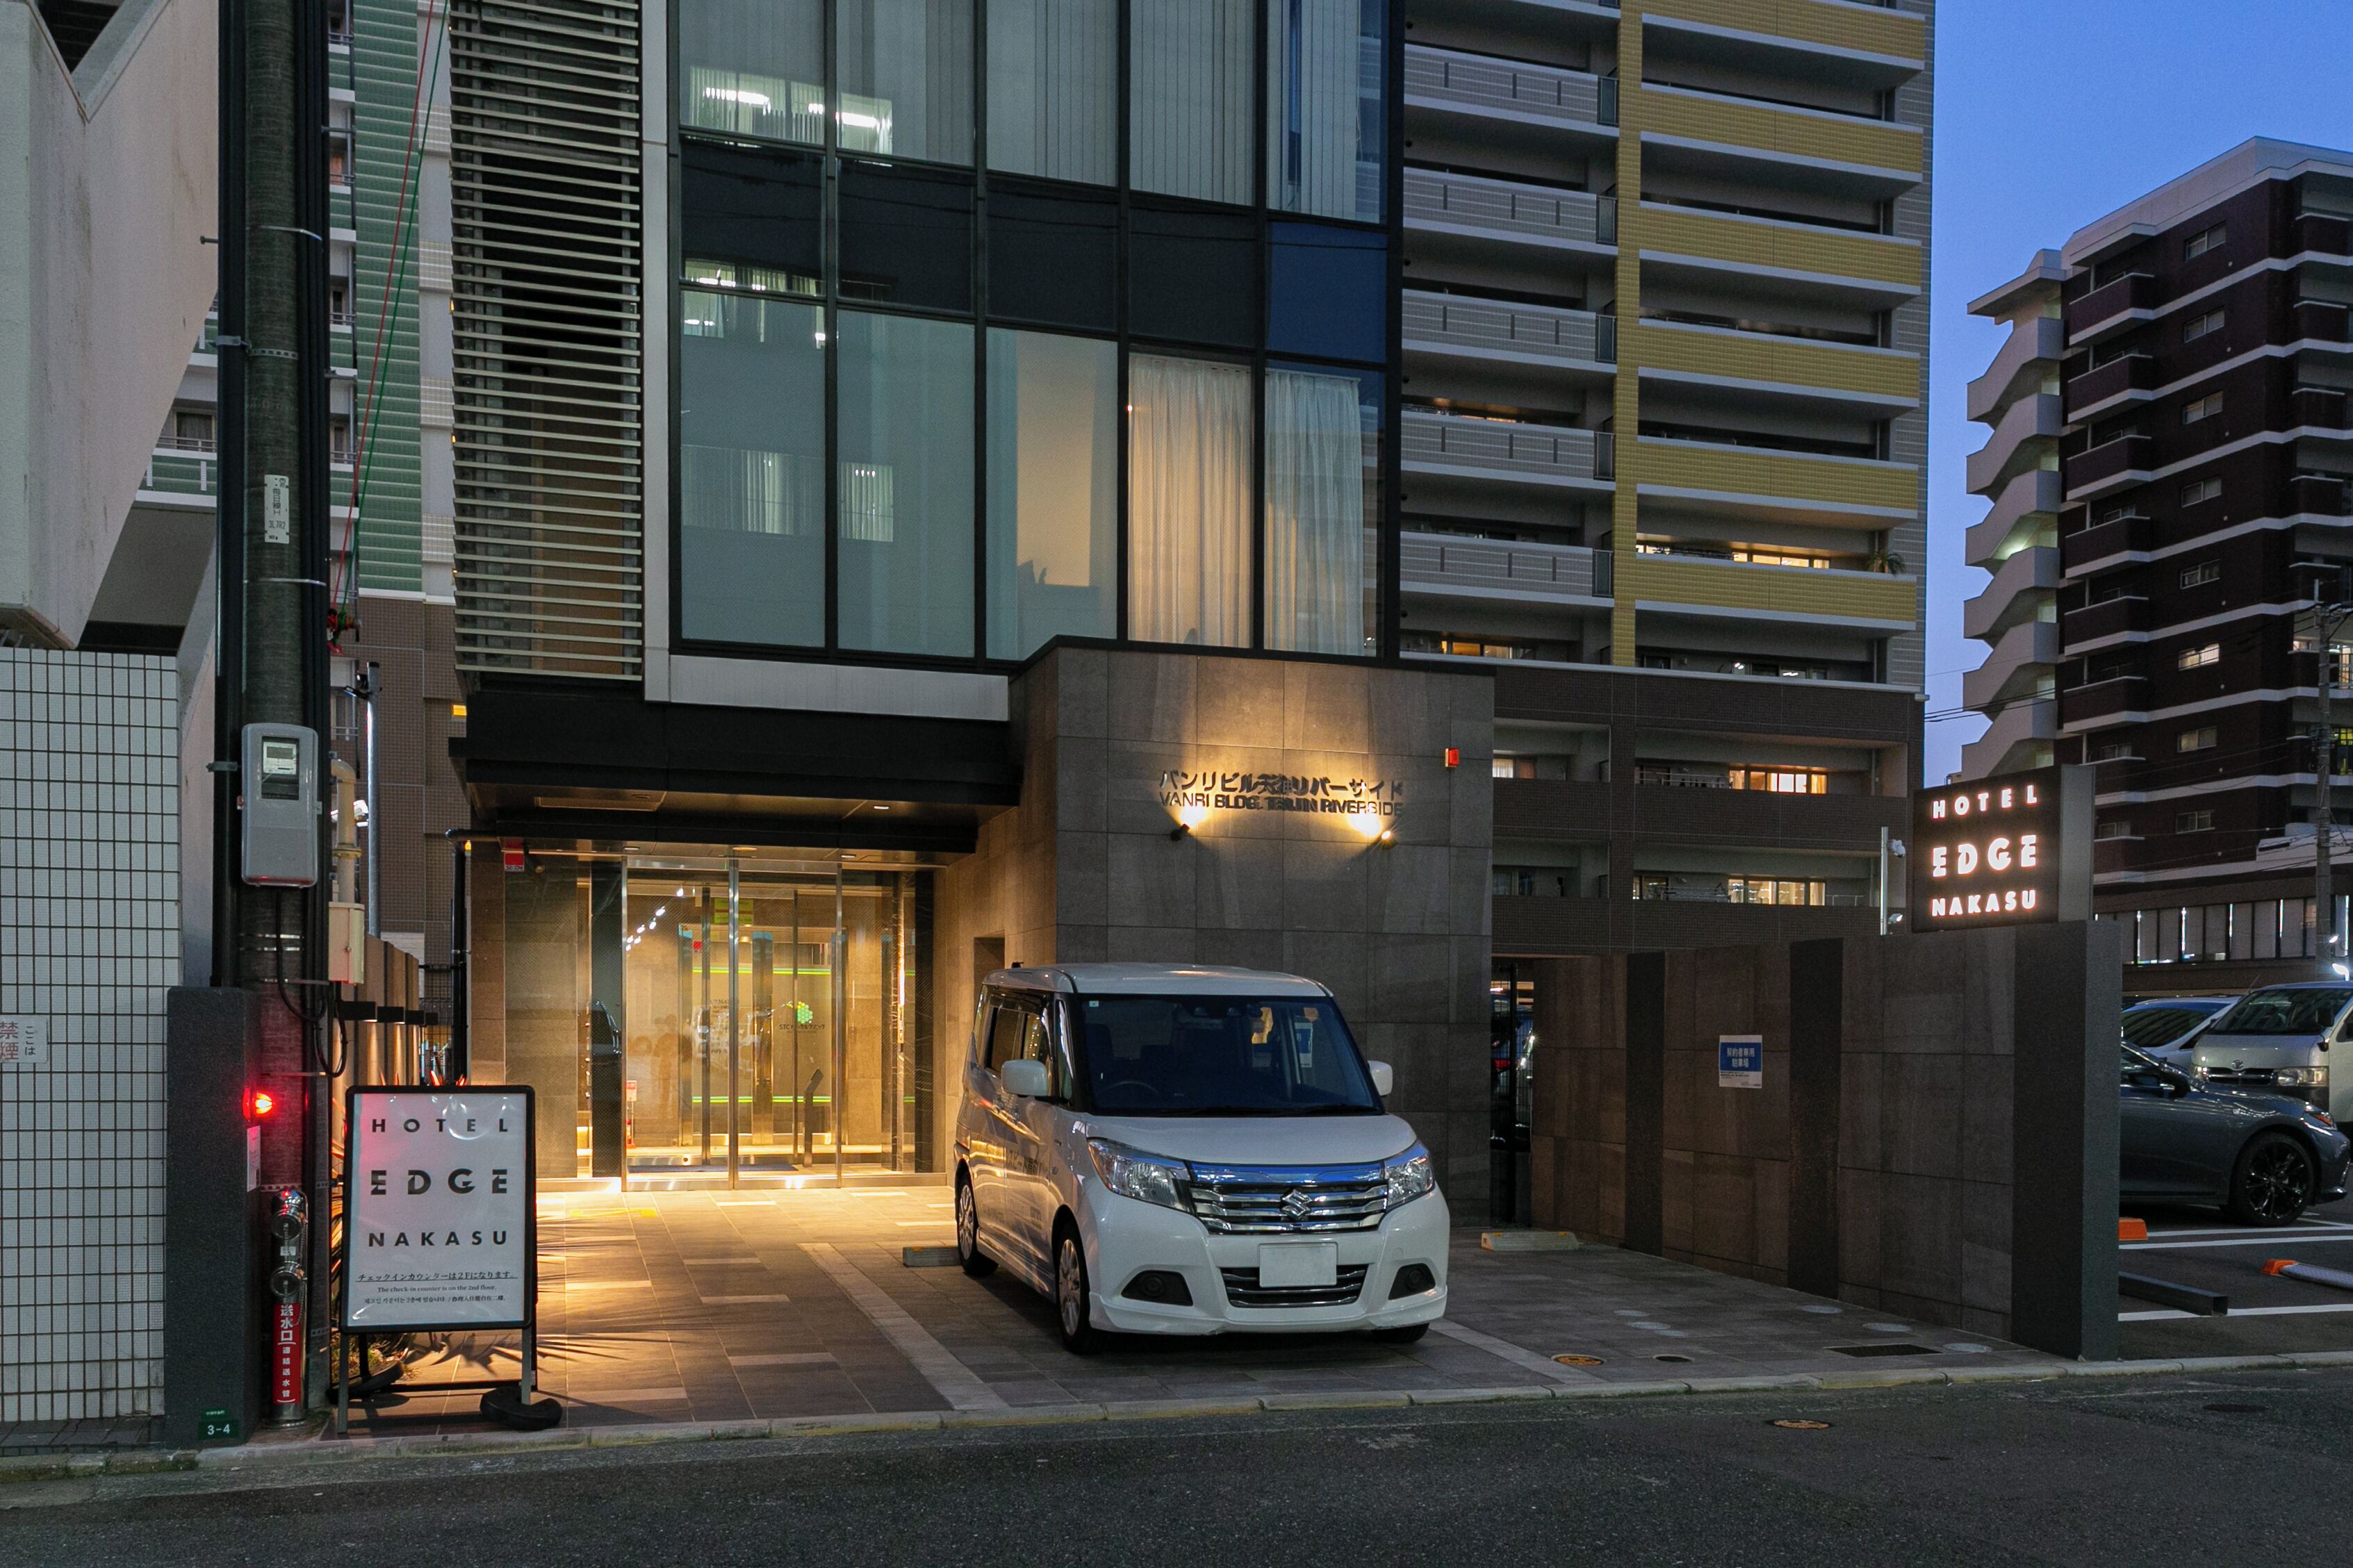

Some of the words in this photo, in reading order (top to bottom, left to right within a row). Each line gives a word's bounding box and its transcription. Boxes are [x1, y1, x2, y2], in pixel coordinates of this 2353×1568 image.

[1159, 769, 1403, 801] バンリビル天神リバーサイド
[1160, 791, 1210, 808] VANRI
[1214, 794, 1263, 810] BLDG.
[1265, 796, 1318, 811] TENJIN
[1320, 798, 1404, 816] RIVERSIDE
[1932, 785, 2038, 819] HOTEL
[1932, 834, 2037, 877] EDGE
[1932, 890, 2036, 916] NAKASU
[25, 1025, 36, 1056] ここは
[372, 1119, 508, 1132] HOTEL
[370, 1169, 507, 1195] EDGE
[368, 1231, 507, 1247] NAKASU
[281, 1305, 293, 1342] 送水口
[208, 1423, 231, 1435] 3-4
